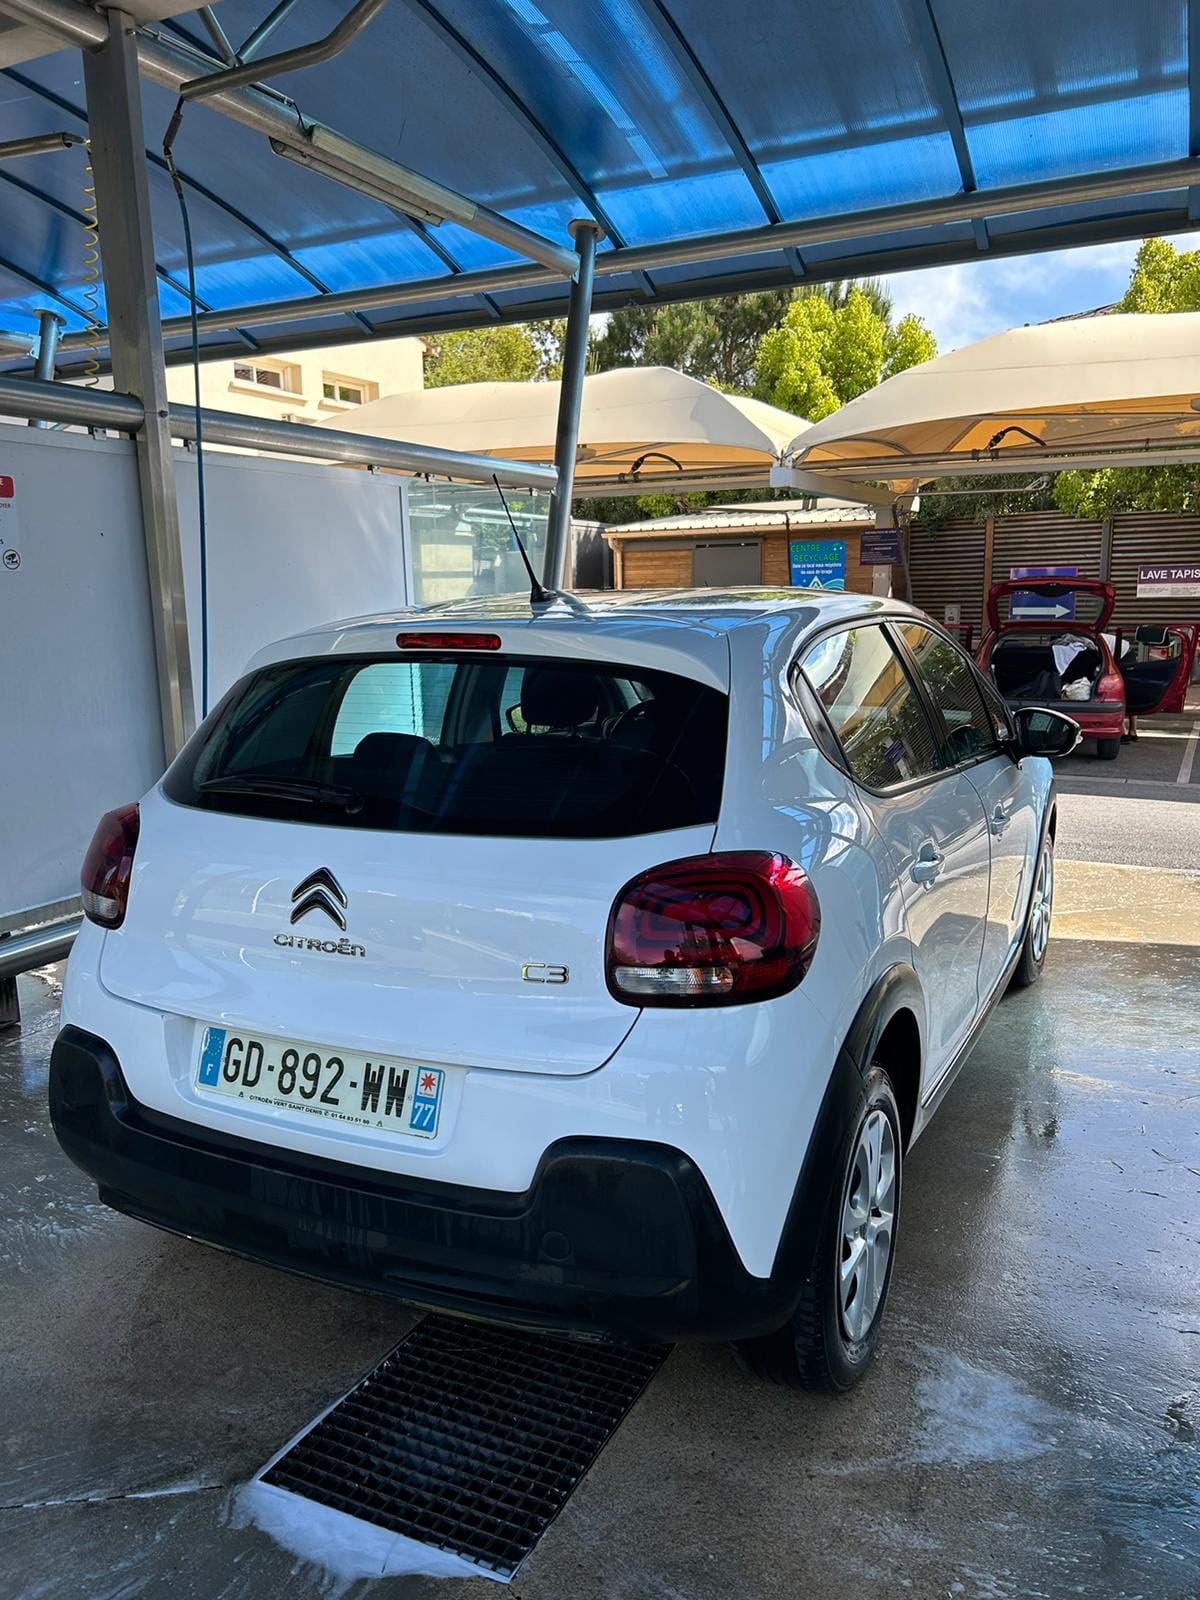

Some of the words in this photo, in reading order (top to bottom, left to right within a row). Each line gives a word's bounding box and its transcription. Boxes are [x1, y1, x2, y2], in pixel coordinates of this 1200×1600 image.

[791, 544, 820, 553] CENTRE
[794, 554, 840, 562] RECYCLAGE
[1140, 570, 1168, 580] LAVE
[1170, 569, 1200, 579] TAPIS
[521, 963, 570, 984] C3
[206, 1063, 214, 1076] F
[273, 1099, 289, 1108] VERT
[288, 1103, 305, 1112] SAINT
[305, 1107, 323, 1116] DENIS
[412, 1101, 435, 1127] 77
